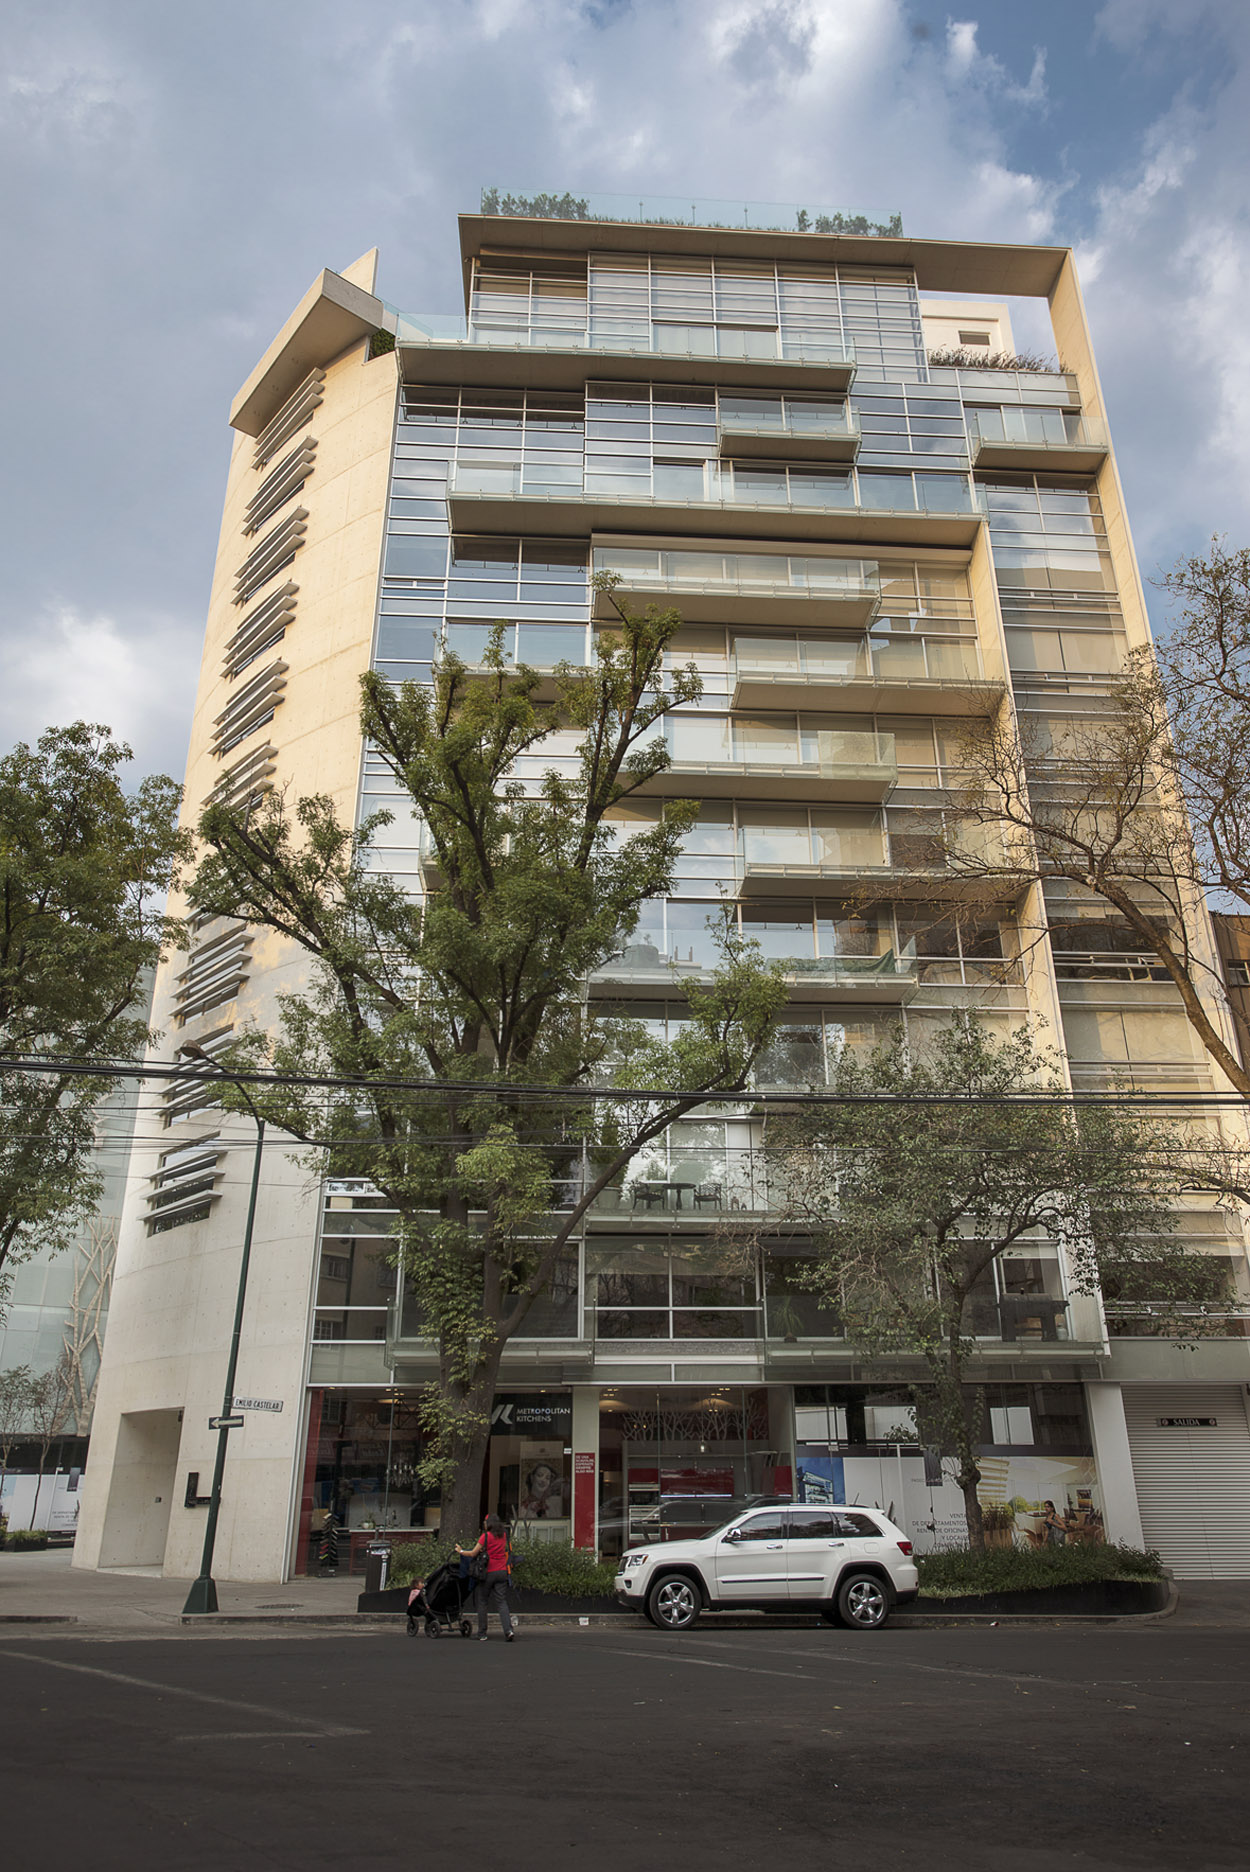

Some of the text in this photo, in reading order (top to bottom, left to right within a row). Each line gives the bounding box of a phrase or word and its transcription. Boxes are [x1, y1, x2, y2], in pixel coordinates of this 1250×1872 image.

[235, 1398, 279, 1409] EMILIO CASTELAR
[1172, 1418, 1200, 1426] SALIDA
